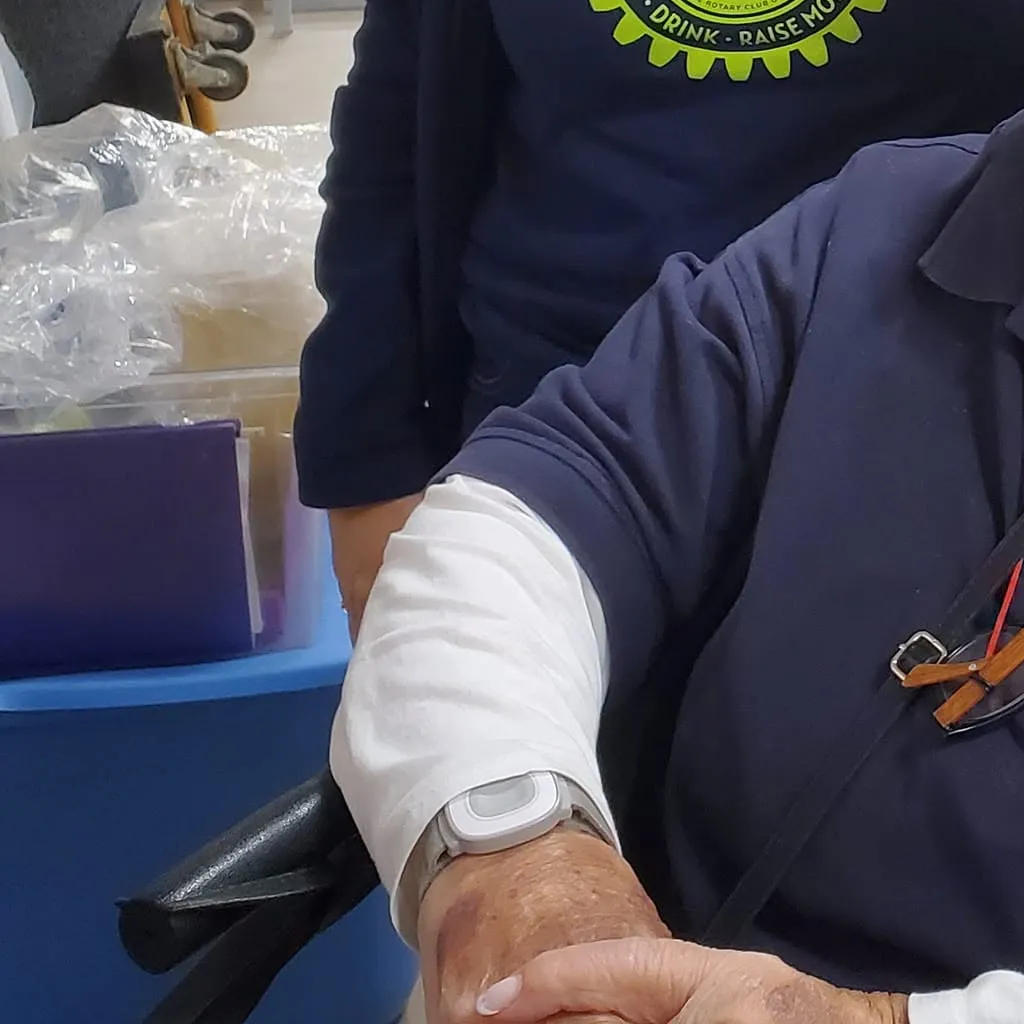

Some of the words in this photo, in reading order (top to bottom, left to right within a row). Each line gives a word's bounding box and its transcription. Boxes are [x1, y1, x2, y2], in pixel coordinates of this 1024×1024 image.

[705, 0, 742, 11] ROTARY
[744, 0, 769, 11] CLUB
[649, 3, 720, 45] DRINK
[740, 18, 804, 46] RAISE
